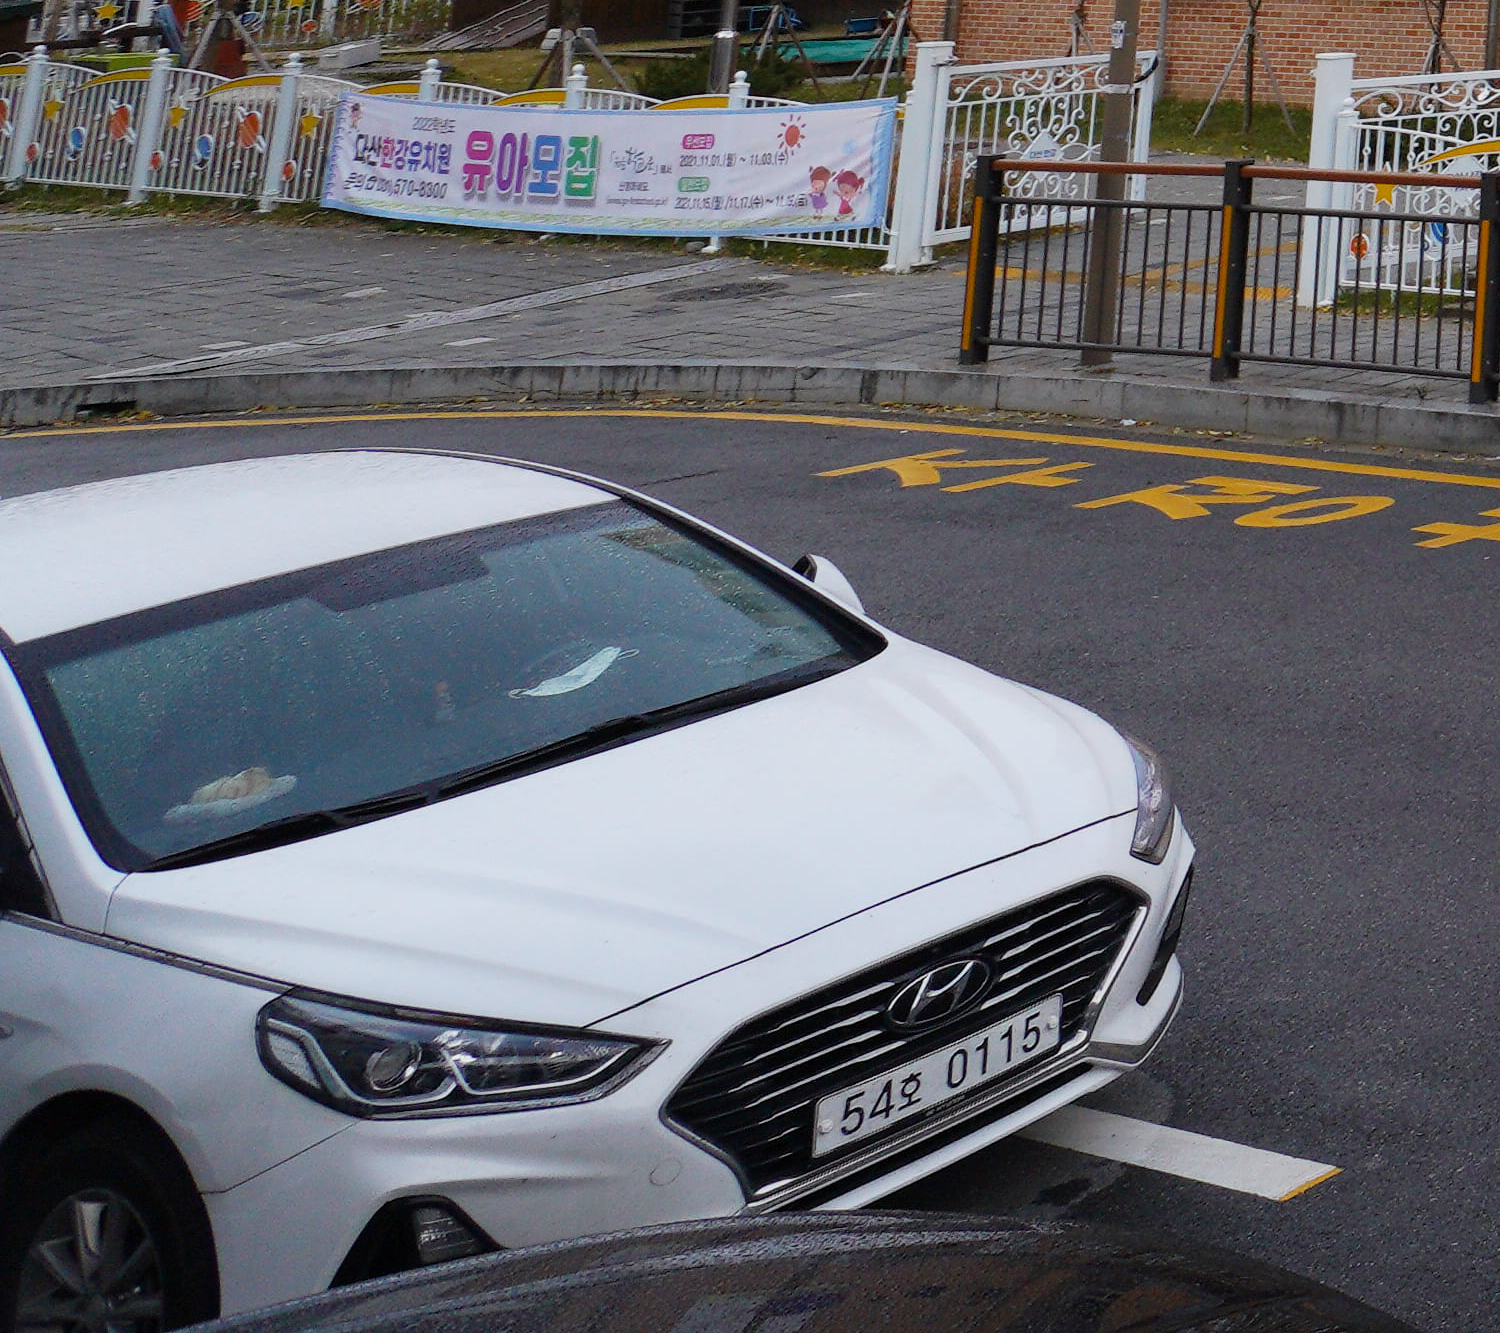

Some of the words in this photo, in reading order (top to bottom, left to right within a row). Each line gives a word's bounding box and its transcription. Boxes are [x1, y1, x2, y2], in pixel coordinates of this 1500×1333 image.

[353, 133, 453, 175] 다산한강유치원
[462, 130, 600, 203] 유아모집
[840, 1072, 922, 1135] 54호
[946, 1011, 1043, 1090] 0115
